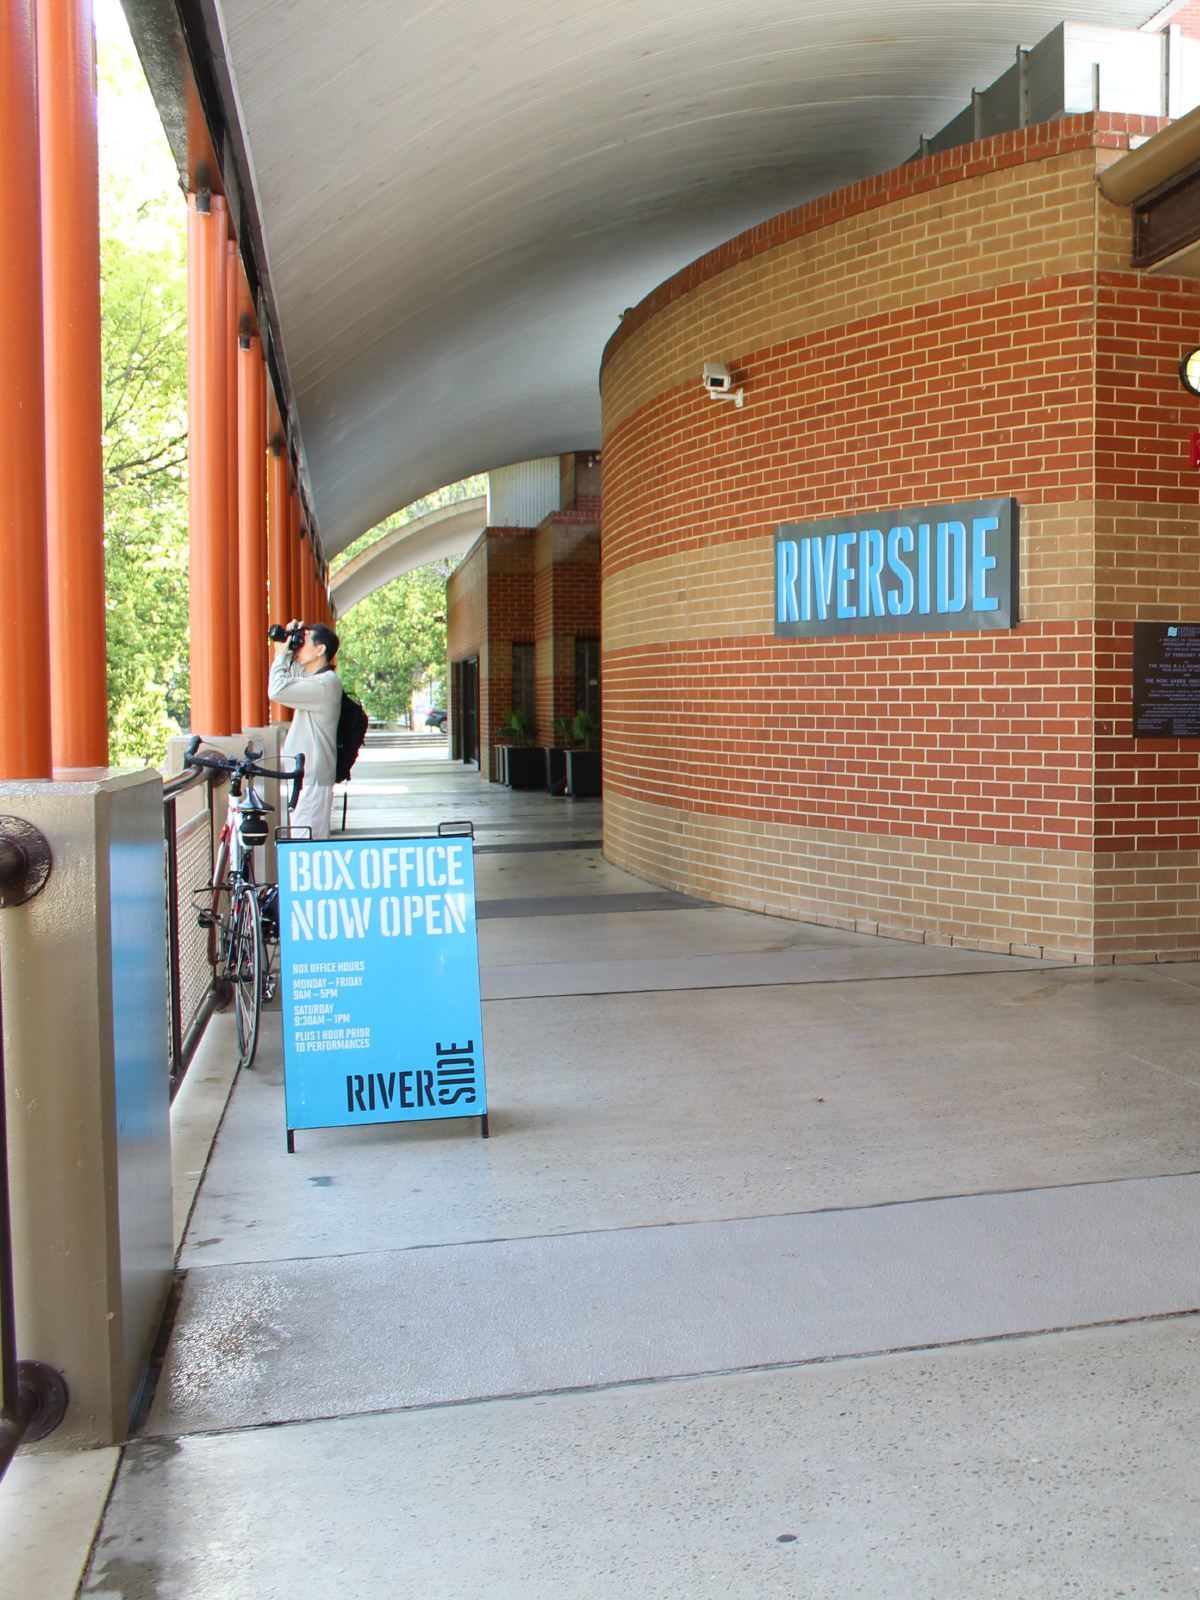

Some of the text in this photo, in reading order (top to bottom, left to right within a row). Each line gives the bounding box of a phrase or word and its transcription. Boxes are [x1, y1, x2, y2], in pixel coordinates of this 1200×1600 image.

[777, 516, 999, 623] RIVERSIDE
[289, 846, 464, 892] BOX OFFICE
[292, 893, 466, 942] NOW OPEN
[292, 961, 365, 975] BOX OFFICE HOURS
[293, 978, 327, 989] MONDAY
[336, 976, 363, 987] FRIDAY
[294, 989, 312, 1000] 9AM
[320, 988, 338, 999] 5PM
[294, 1004, 334, 1016] SATURDAY
[294, 1015, 326, 1026] 9:30AM
[334, 1013, 351, 1024] 1PM
[295, 1030, 316, 1042] PLUS
[322, 1029, 344, 1039] HOUR
[346, 1027, 371, 1038] PRIOR
[296, 1038, 370, 1052] TO PERFORMANCES
[346, 1069, 436, 1113] RIVER
